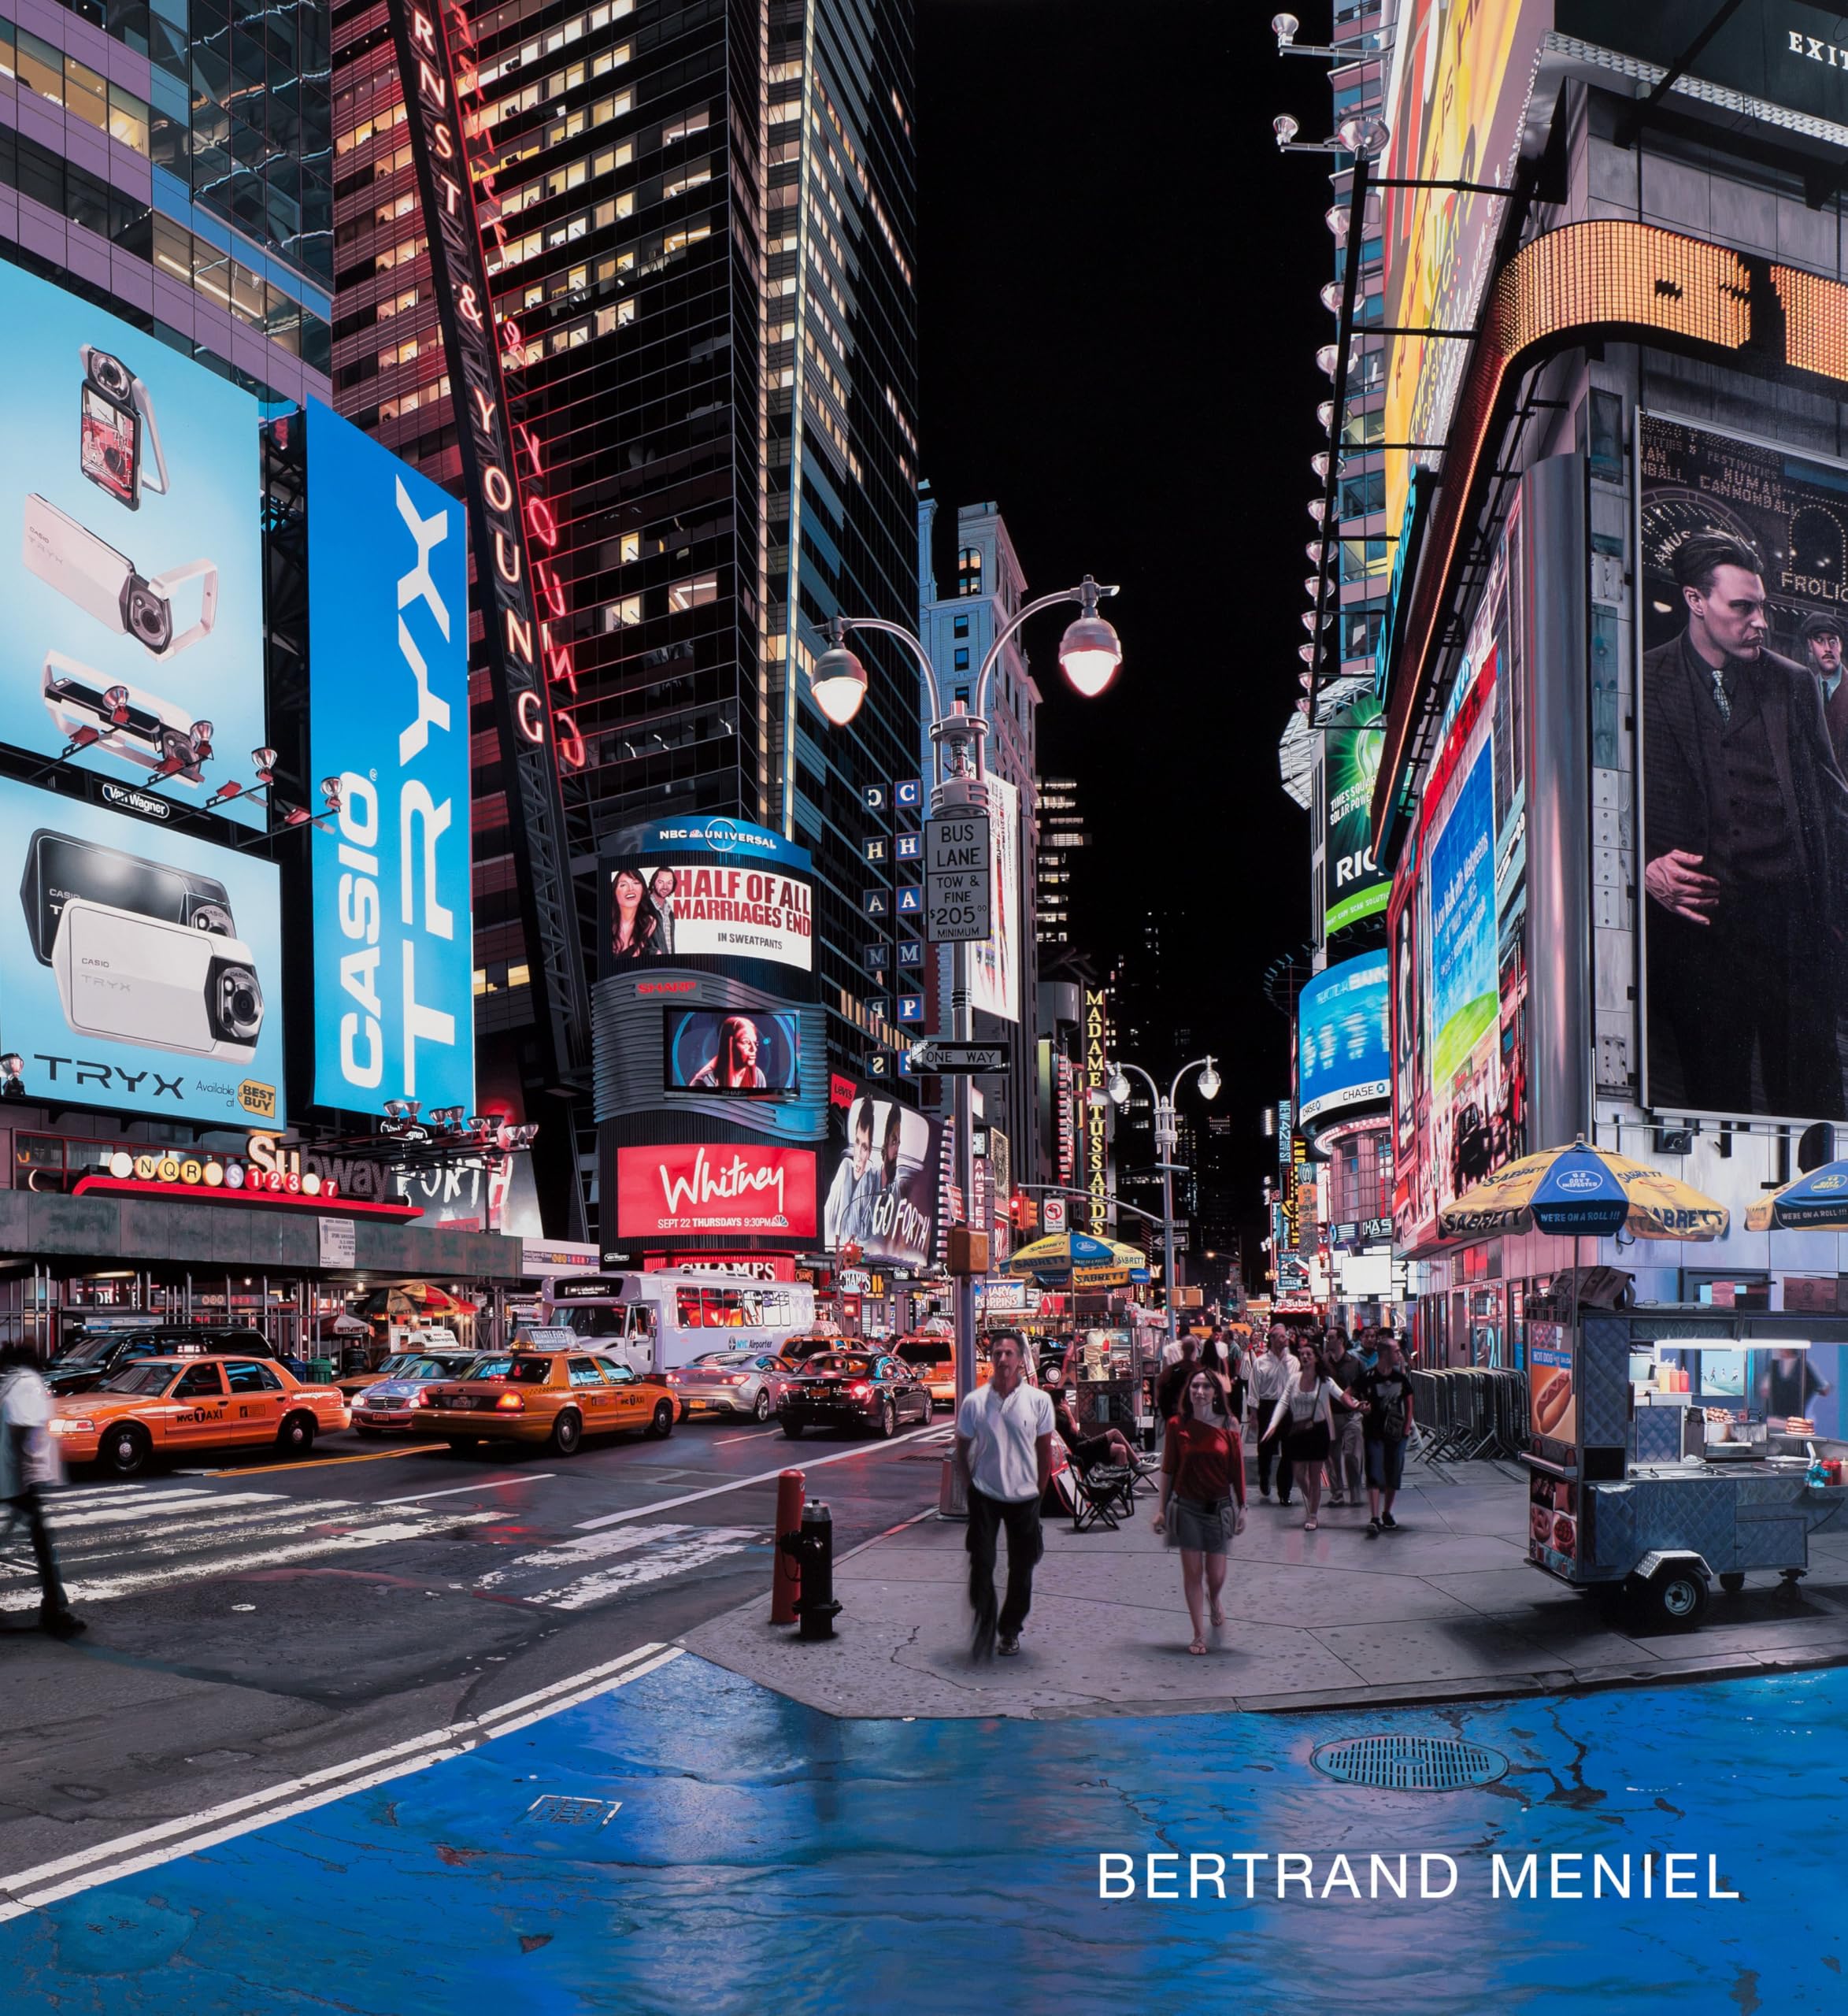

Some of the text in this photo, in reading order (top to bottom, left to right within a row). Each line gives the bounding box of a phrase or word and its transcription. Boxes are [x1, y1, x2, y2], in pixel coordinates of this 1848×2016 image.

[460, 284, 483, 331] &
[474, 386, 545, 744] YOUNG
[396, 474, 454, 1097] TRYX
[1330, 774, 1377, 813] TIMES SQUAR
[1330, 792, 1372, 826] SOLAR POWE
[659, 829, 777, 850] NBC UNIVERSAL
[941, 824, 974, 844] BUS
[937, 847, 981, 867] LANE
[1336, 844, 1385, 888] RIC
[936, 874, 980, 888] TOW &
[675, 869, 810, 916] HALF OF ALL
[944, 890, 972, 903] FINE
[674, 899, 812, 938] MARRIAGES END
[339, 771, 383, 1088] CASIO
[937, 926, 980, 939] MINIMUM
[717, 932, 783, 951] IN SWEATPANTS
[81, 957, 110, 969] CASIO
[637, 981, 697, 995] SHARP
[1086, 990, 1105, 1087] MADAME
[926, 1051, 995, 1064] ONE WAY
[34, 1054, 185, 1099] TRYX
[196, 1080, 235, 1096] Available
[243, 1085, 276, 1100] BEST
[1342, 1085, 1375, 1102] CHASE
[243, 1095, 272, 1112] BUY
[247, 1136, 391, 1203] Subway
[1482, 1166, 1549, 1188] SABRETT
[1617, 1169, 1663, 1184] SABRETT
[659, 1147, 784, 1214] Whitney
[657, 1217, 771, 1229] SEPT 22 THURSDAYS 9:30PM
[872, 1193, 895, 1236] GO
[891, 1198, 931, 1251] FORTH
[1443, 1206, 1521, 1232] SABRETT
[1588, 1210, 1608, 1221] ROLL
[1362, 1219, 1392, 1238] CHAS
[1015, 1256, 1066, 1269] SABRETT
[839, 1269, 871, 1292] CHAMPS
[975, 1295, 1019, 1309] POPPINS
[748, 1338, 772, 1351] Airporter
